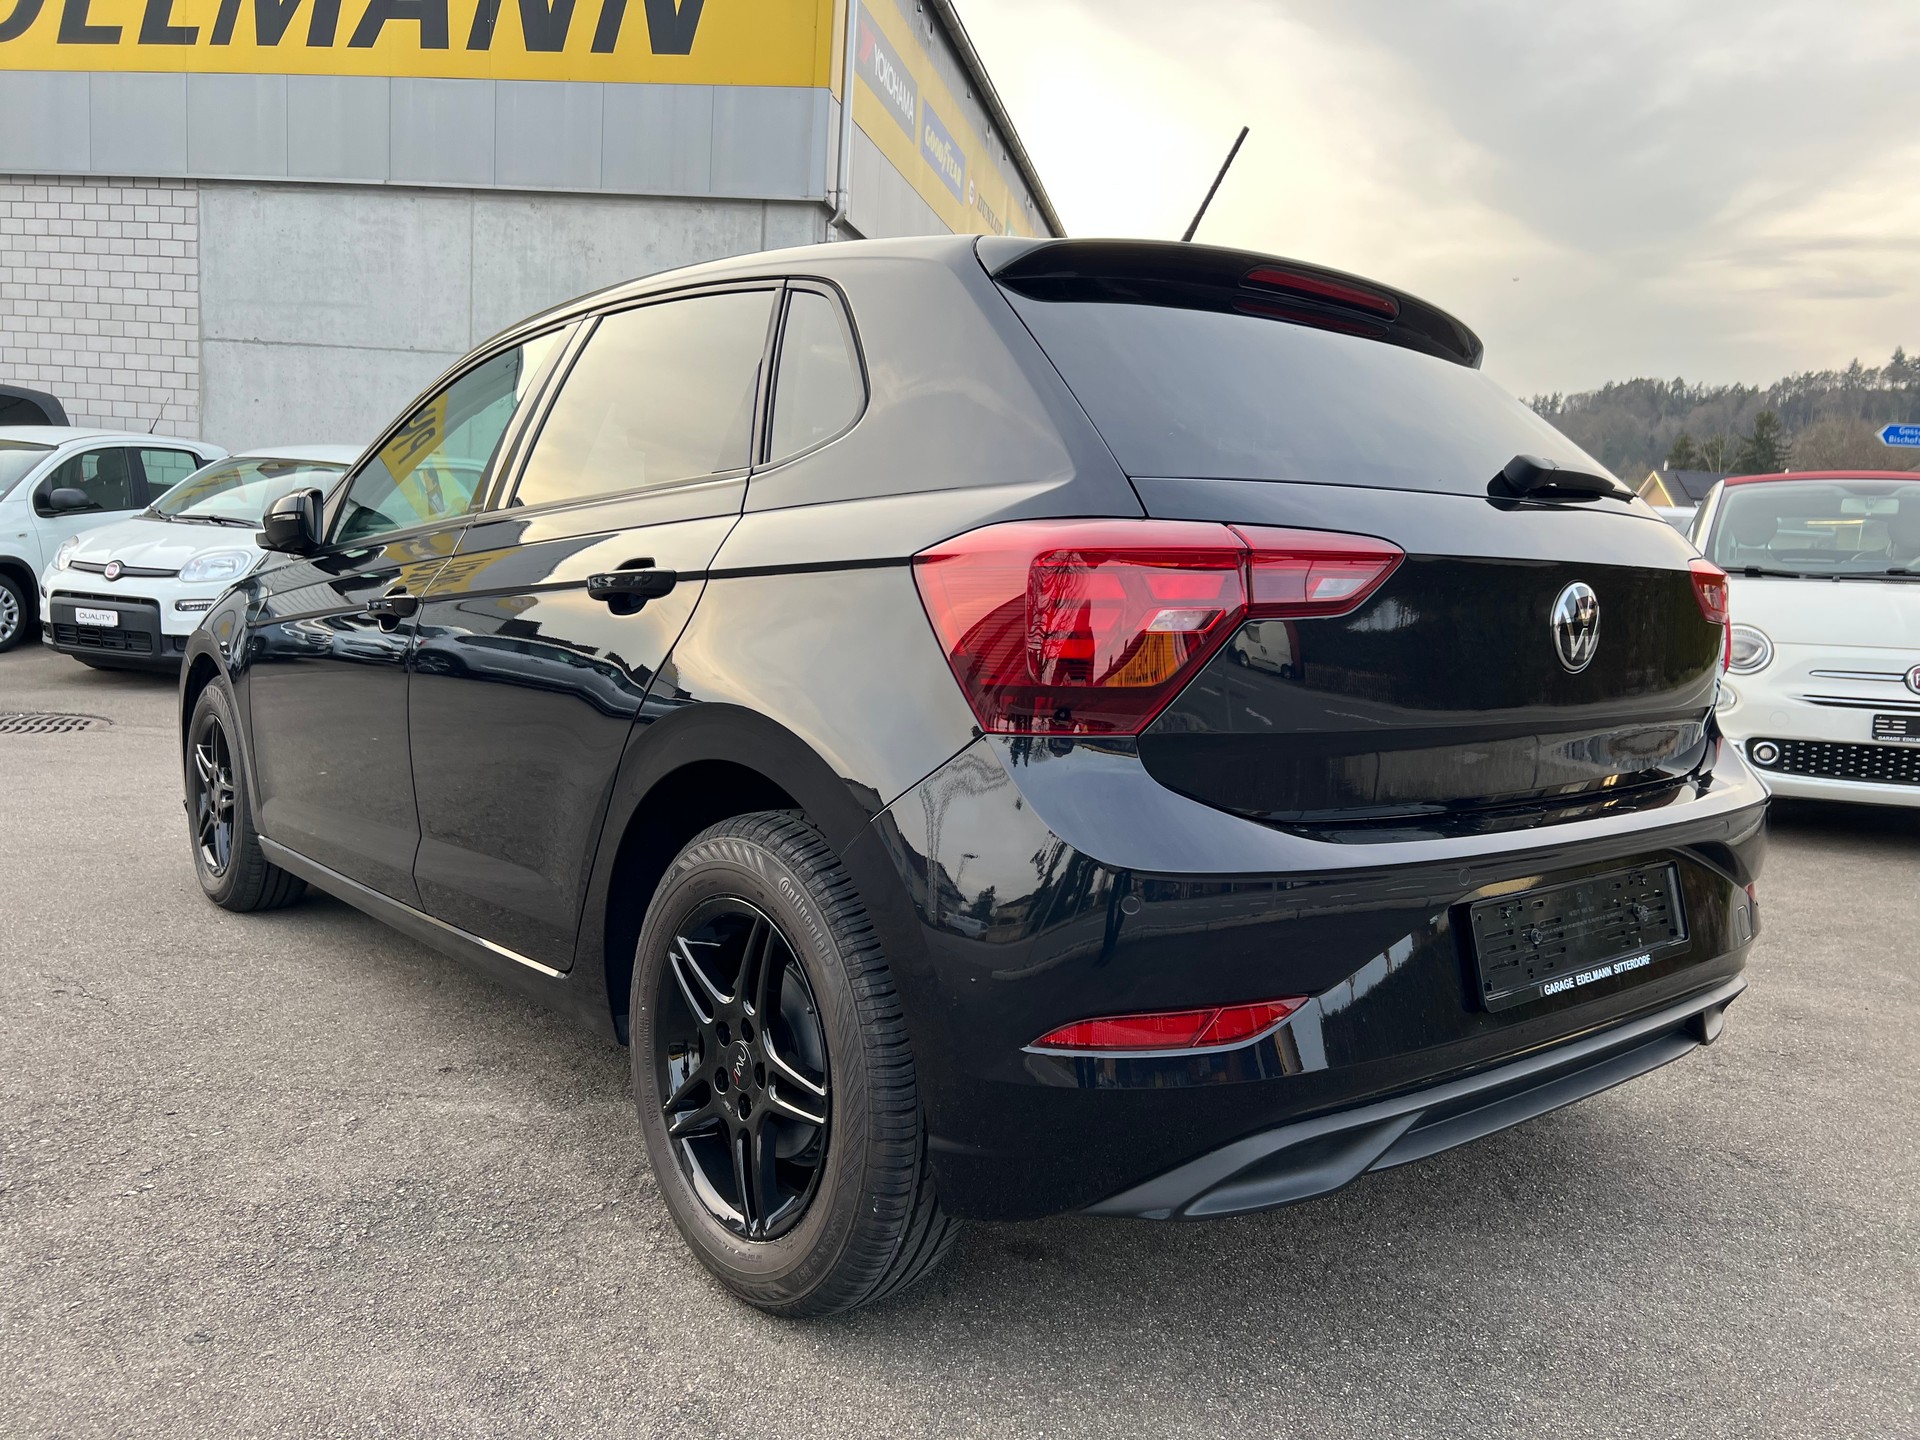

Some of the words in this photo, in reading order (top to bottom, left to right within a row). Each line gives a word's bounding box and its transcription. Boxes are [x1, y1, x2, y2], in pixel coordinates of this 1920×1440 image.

[874, 43, 914, 125] YOKOHAMA
[924, 125, 962, 189] GOODYEAR
[778, 877, 831, 960] Continental
[1544, 977, 1574, 996] GARAGE
[1576, 965, 1612, 986] EDELMANN
[1613, 954, 1652, 974] SITTERDORF
